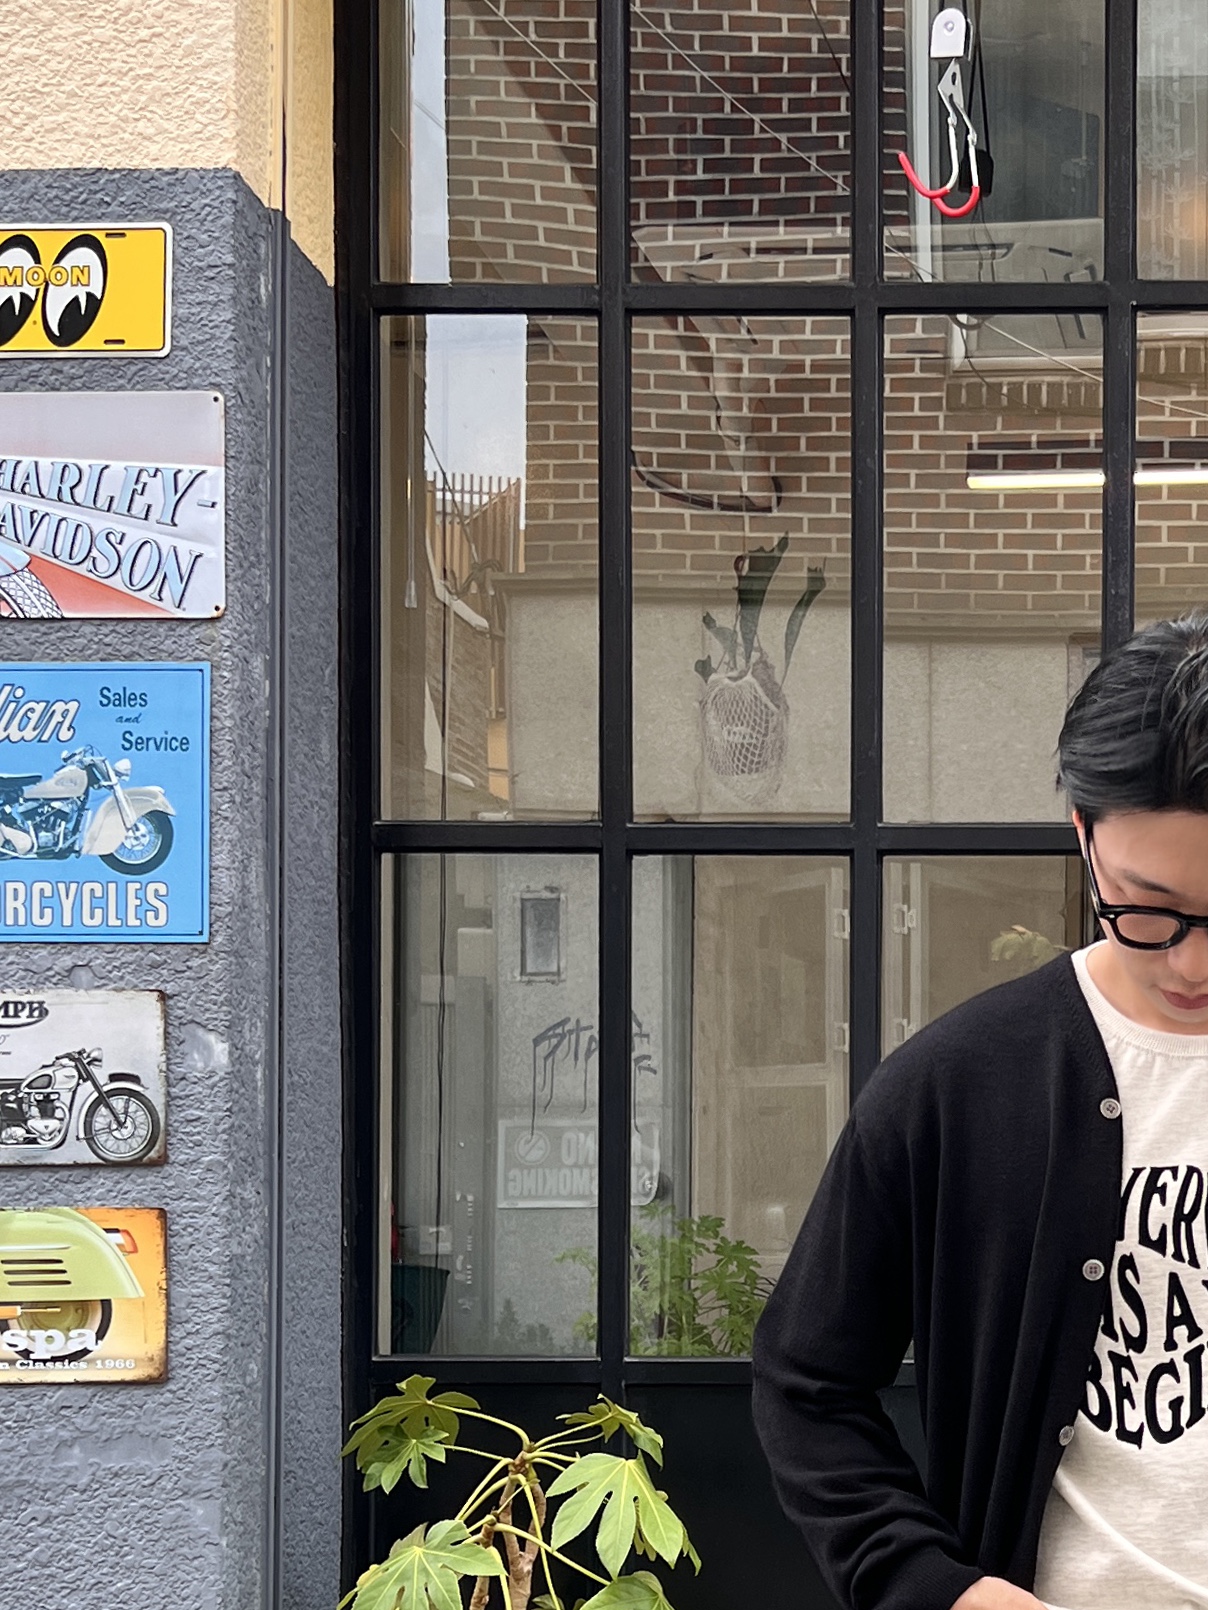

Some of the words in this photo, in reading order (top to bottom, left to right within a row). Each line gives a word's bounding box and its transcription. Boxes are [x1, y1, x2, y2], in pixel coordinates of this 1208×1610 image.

[0, 264, 91, 288] MOON
[99, 686, 148, 707] Sales
[115, 713, 142, 724] and
[121, 730, 190, 752] Service
[1164, 1271, 1204, 1352] A
[2, 1328, 101, 1359] spa
[15, 1359, 88, 1370] Classics
[95, 1359, 136, 1370] 1966
